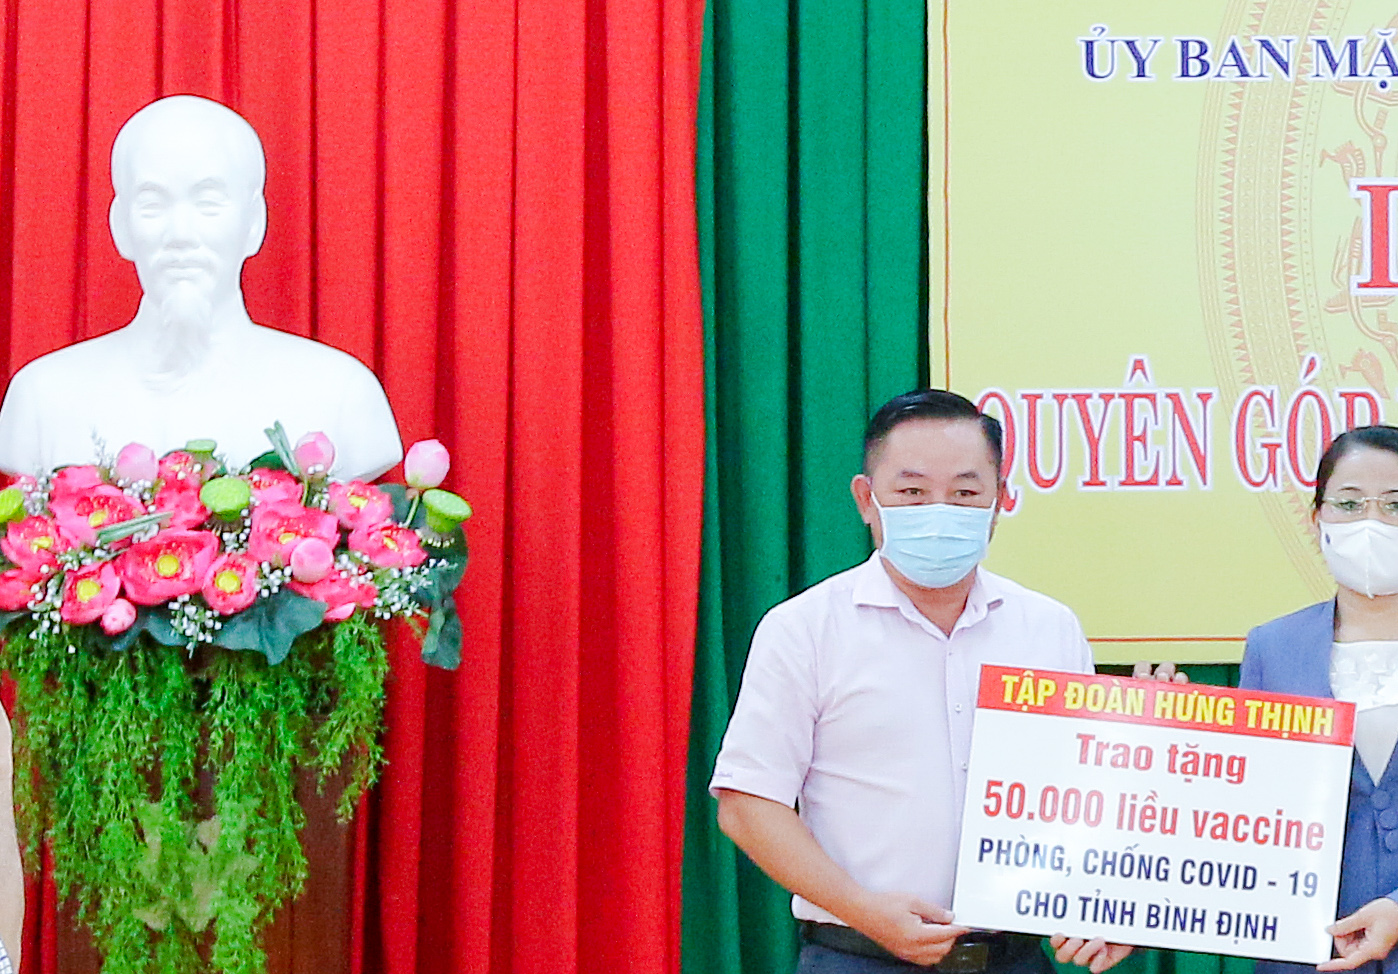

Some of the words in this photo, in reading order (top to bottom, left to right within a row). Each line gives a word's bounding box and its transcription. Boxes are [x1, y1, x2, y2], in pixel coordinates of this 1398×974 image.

[1081, 26, 1159, 80] ỦY
[1175, 38, 1294, 79] BAN
[976, 357, 1213, 512] QUYÊN
[1001, 670, 1057, 711] TẬP
[1064, 680, 1146, 717] ĐOÀN
[1153, 690, 1234, 727] HƯNG
[1245, 699, 1335, 740] THỊNH
[1076, 733, 1153, 771] Trao
[1167, 743, 1247, 785] tặng
[983, 779, 1104, 827] 50.000
[1116, 791, 1178, 836] liều
[1192, 809, 1325, 851] vaccine
[978, 835, 1073, 878] PHÒNG,
[1083, 842, 1170, 882] CHỐNG
[1180, 859, 1257, 891] COVID
[1289, 872, 1318, 898] 19
[1016, 889, 1068, 920] CHO
[1078, 889, 1136, 926] TỈNH
[1145, 898, 1206, 934] BÌNH
[1216, 911, 1279, 945] ĐỊNH
